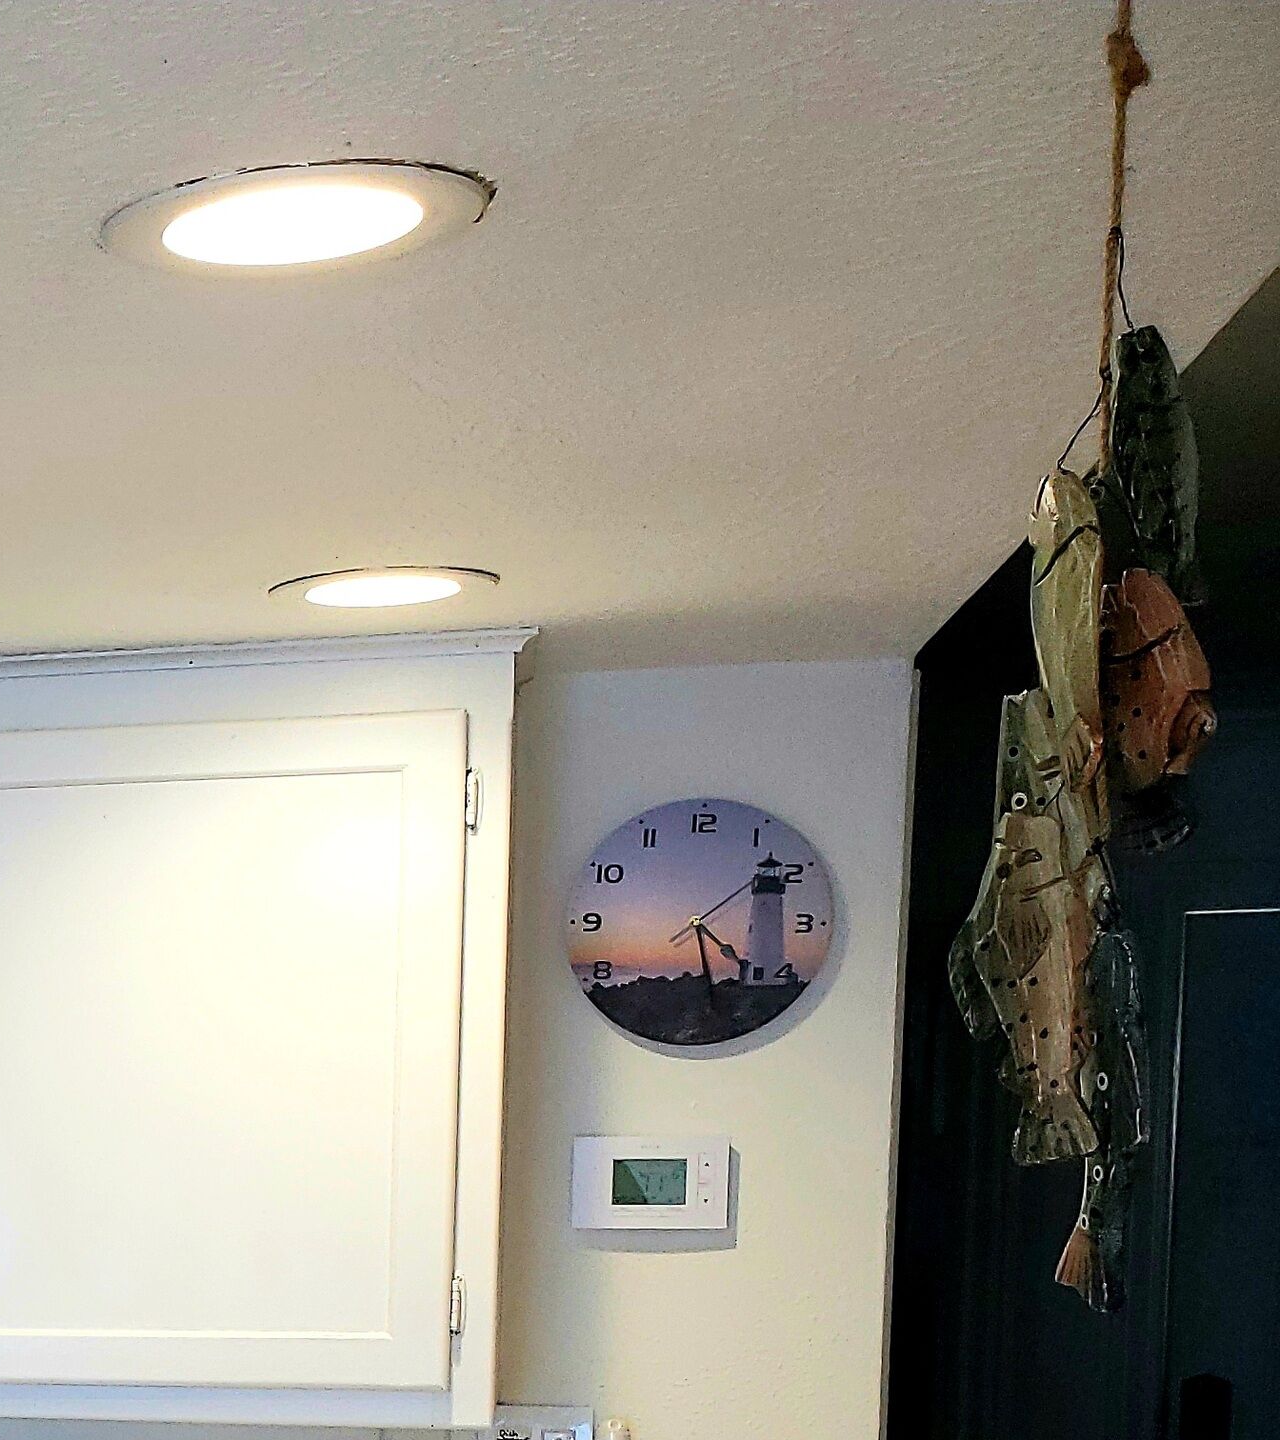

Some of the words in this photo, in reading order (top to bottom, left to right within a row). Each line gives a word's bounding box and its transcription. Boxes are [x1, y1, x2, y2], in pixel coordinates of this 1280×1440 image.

[690, 813, 718, 834] 12
[642, 828, 657, 848] 11
[752, 827, 760, 848] 1
[595, 863, 625, 884] 10
[783, 863, 804, 884] 2
[582, 912, 603, 932] 9
[794, 913, 815, 934] 3
[593, 960, 613, 980] 8
[773, 962, 793, 980] 4
